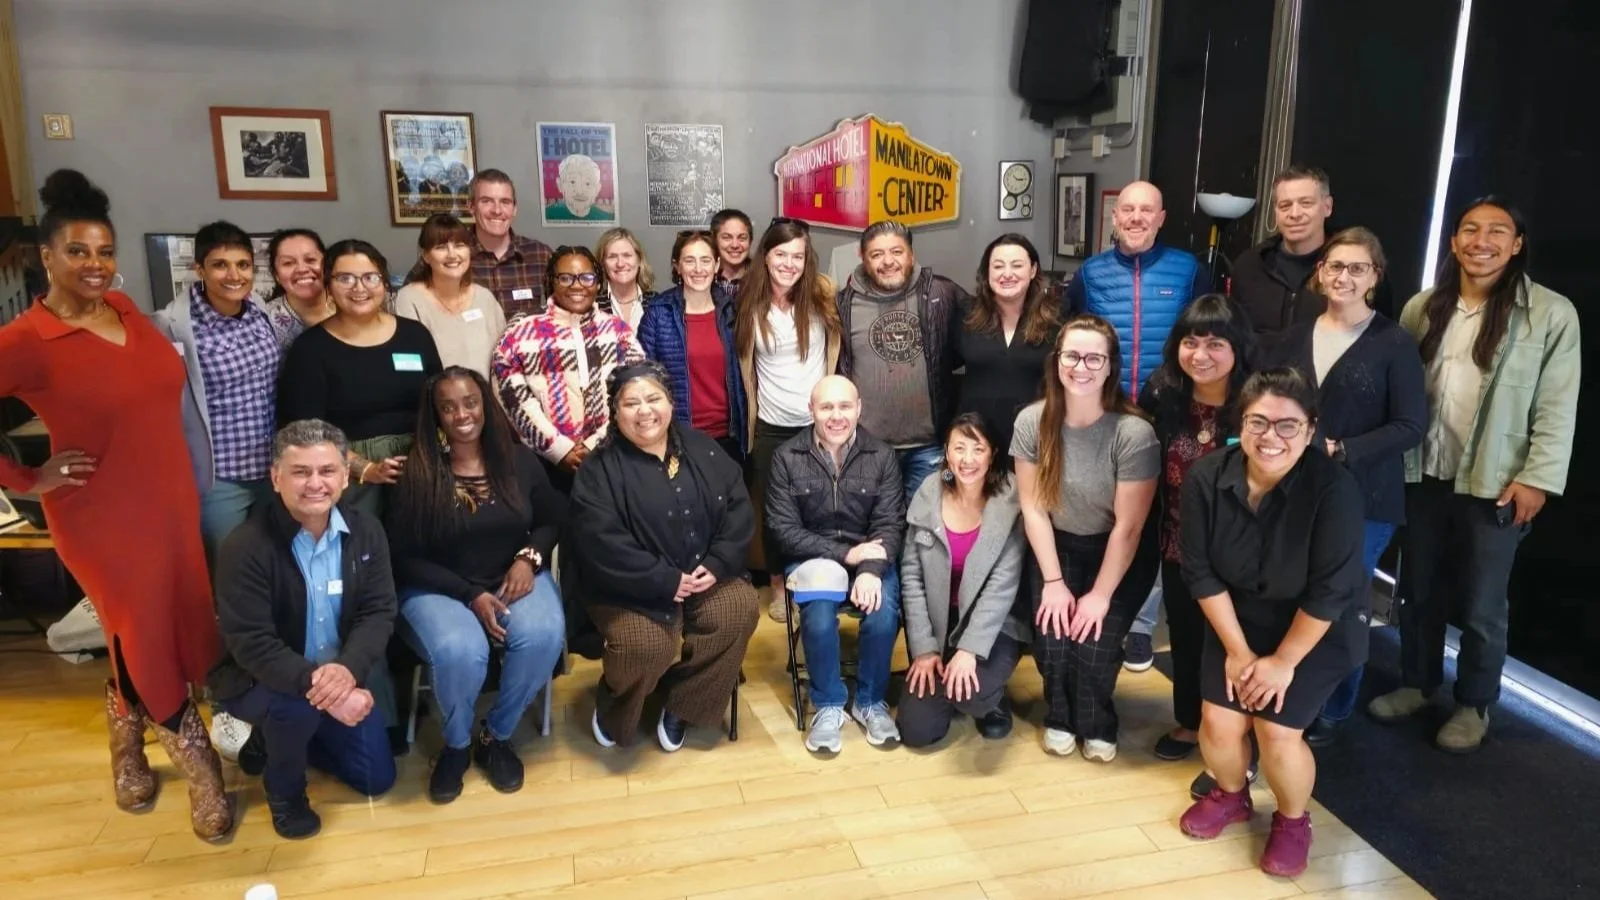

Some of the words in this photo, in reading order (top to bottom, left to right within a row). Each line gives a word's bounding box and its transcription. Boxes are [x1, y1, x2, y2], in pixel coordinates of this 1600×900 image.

[543, 137, 611, 156] I-HOTEL
[783, 141, 832, 177] INTERNATIONAL
[833, 125, 866, 163] HOTEL
[875, 129, 952, 181] MANILATOWN
